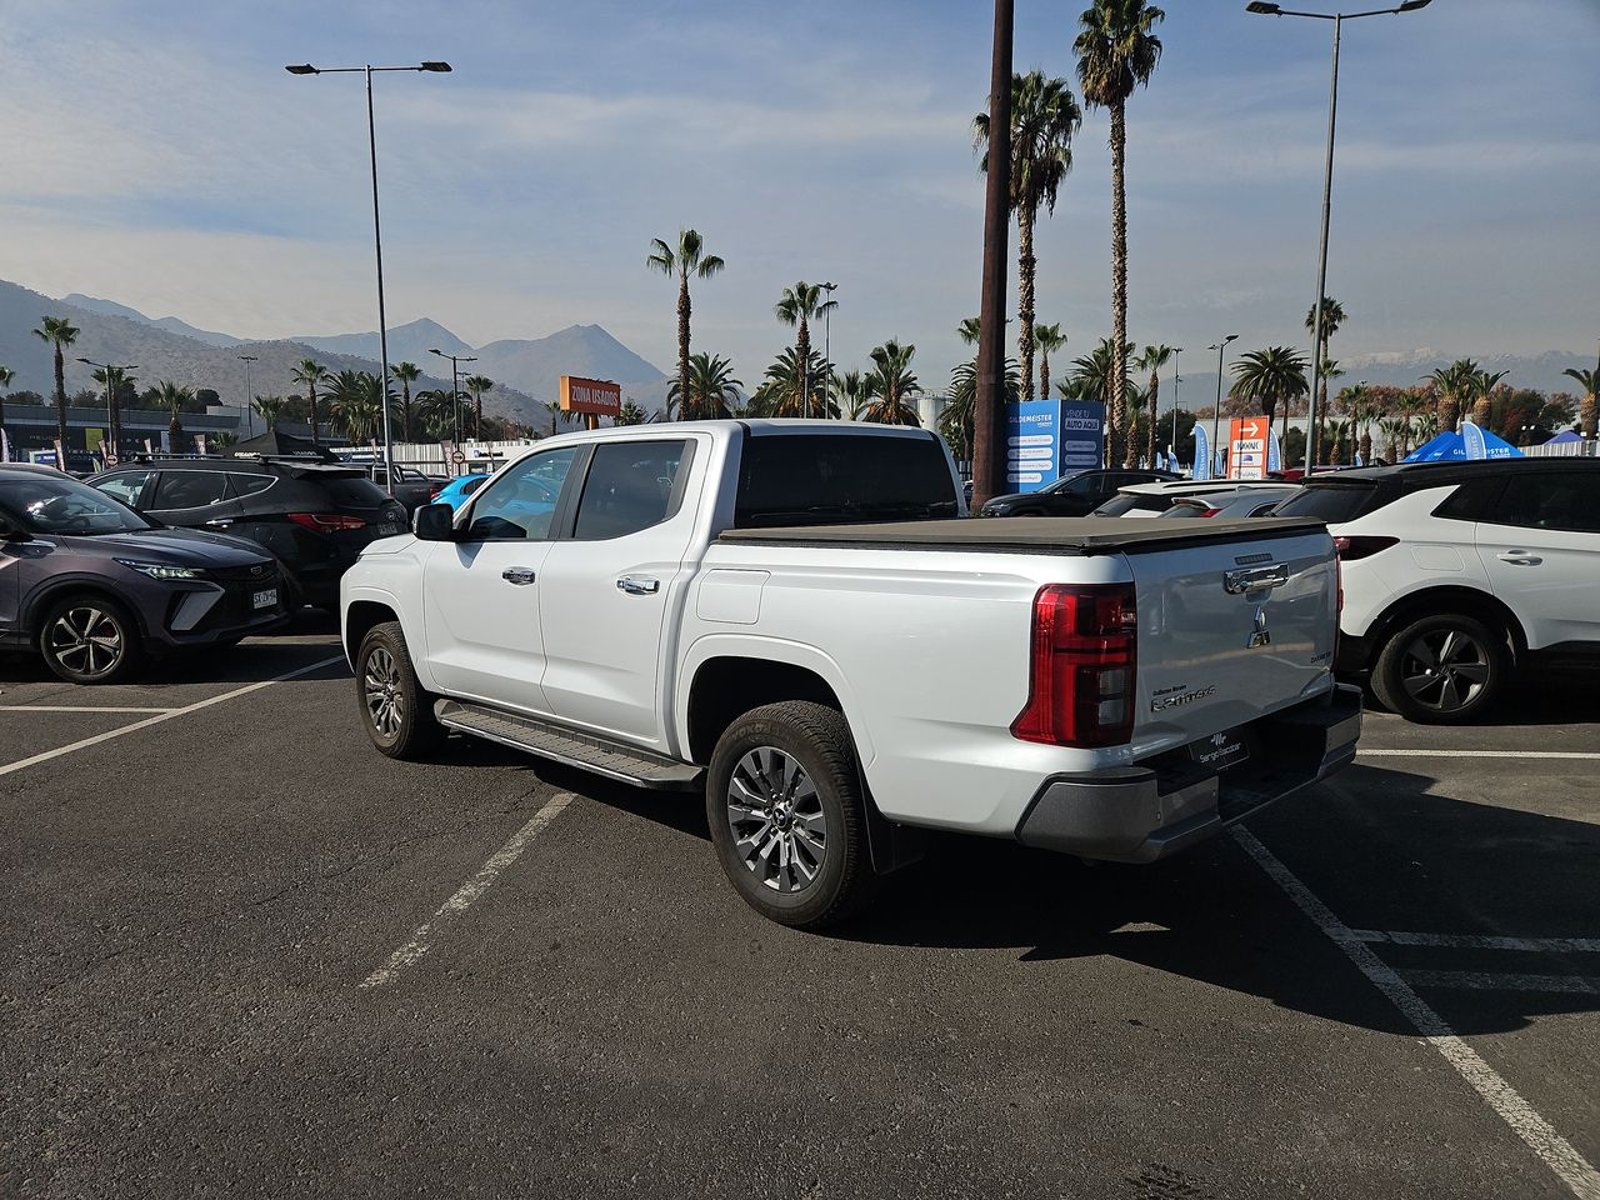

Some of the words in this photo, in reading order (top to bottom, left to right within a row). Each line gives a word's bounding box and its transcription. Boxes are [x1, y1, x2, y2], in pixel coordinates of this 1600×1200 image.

[572, 386, 590, 403] ZONA
[592, 389, 618, 406] USADOS
[1009, 414, 1052, 423] GILDEMEISTER
